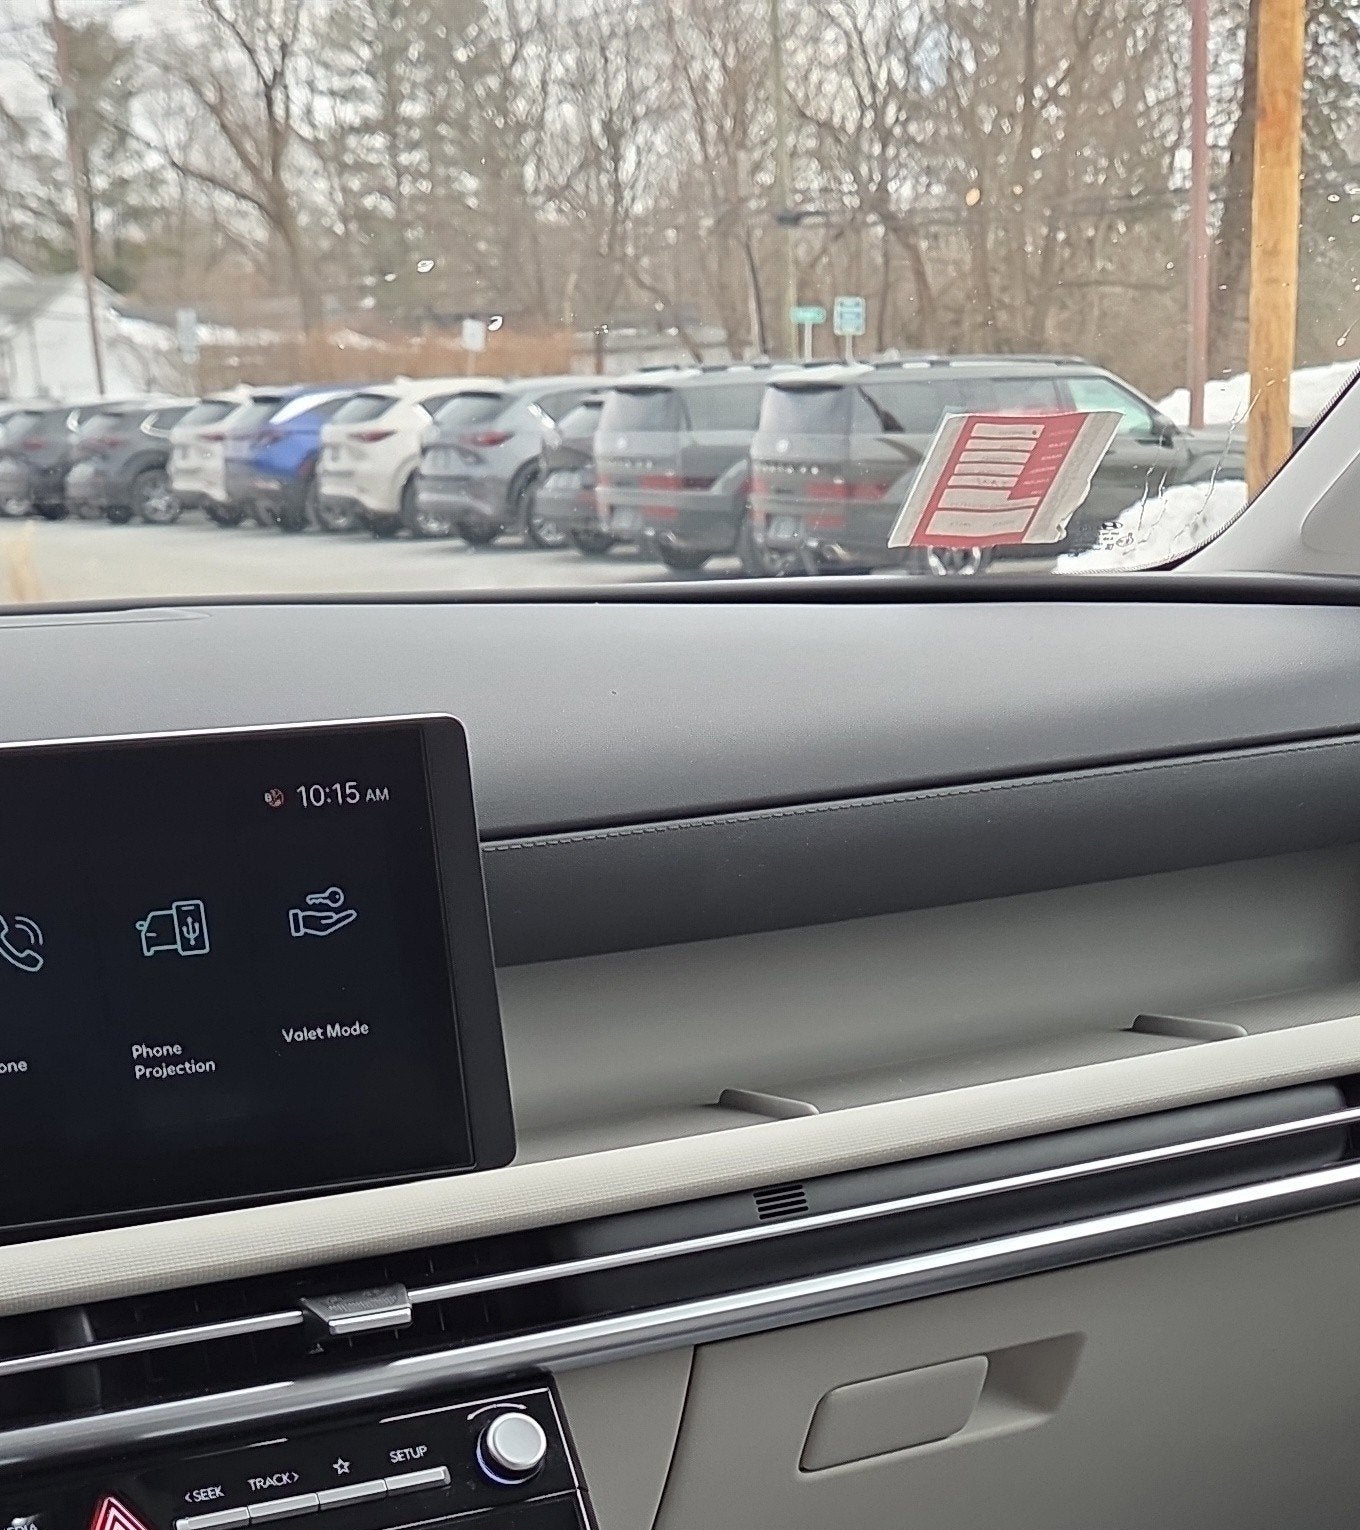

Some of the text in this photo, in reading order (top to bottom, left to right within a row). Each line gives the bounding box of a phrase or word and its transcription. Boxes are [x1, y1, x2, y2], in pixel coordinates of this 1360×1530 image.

[296, 781, 390, 808] 10:15 AM
[281, 1021, 369, 1043] Valet Mode
[131, 1043, 182, 1060] Phone
[134, 1057, 216, 1079] Projection
[389, 1445, 428, 1464] SETUP
